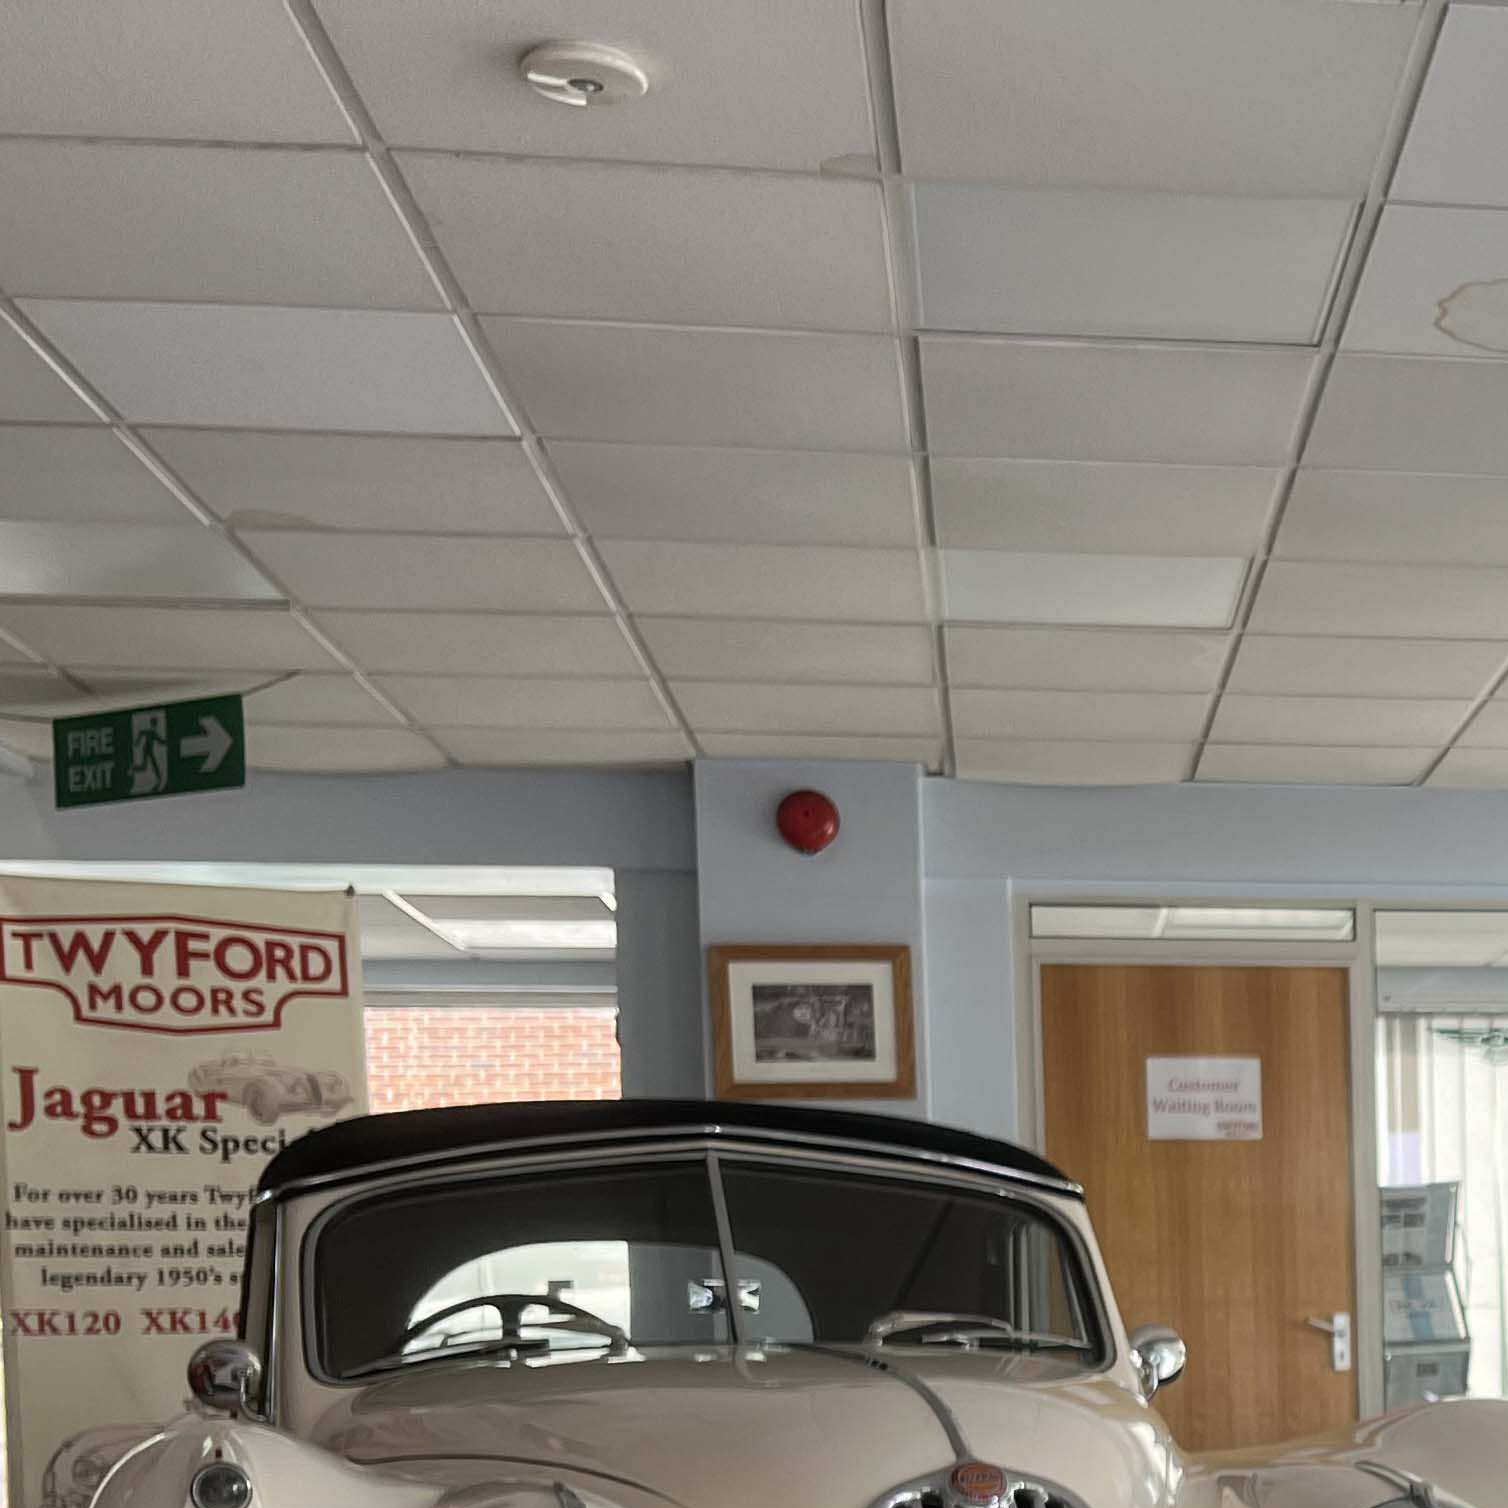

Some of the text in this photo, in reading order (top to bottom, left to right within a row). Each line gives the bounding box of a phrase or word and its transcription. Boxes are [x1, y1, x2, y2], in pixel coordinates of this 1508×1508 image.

[67, 727, 114, 759] FIRE
[68, 761, 115, 792] EXIT
[10, 928, 333, 983] TWYFORD
[87, 981, 266, 1018] MOORS
[7, 1066, 229, 1139] Jaguar
[1152, 1096, 1257, 1117] Waiting Room
[131, 1126, 288, 1164] XK Speci
[13, 1183, 258, 1209] For over 30 years Twyf
[5, 1209, 248, 1235] have specialised in the
[15, 1239, 246, 1258] maintenance and sale
[41, 1266, 148, 1292] legendary
[10, 1310, 122, 1337] XK120
